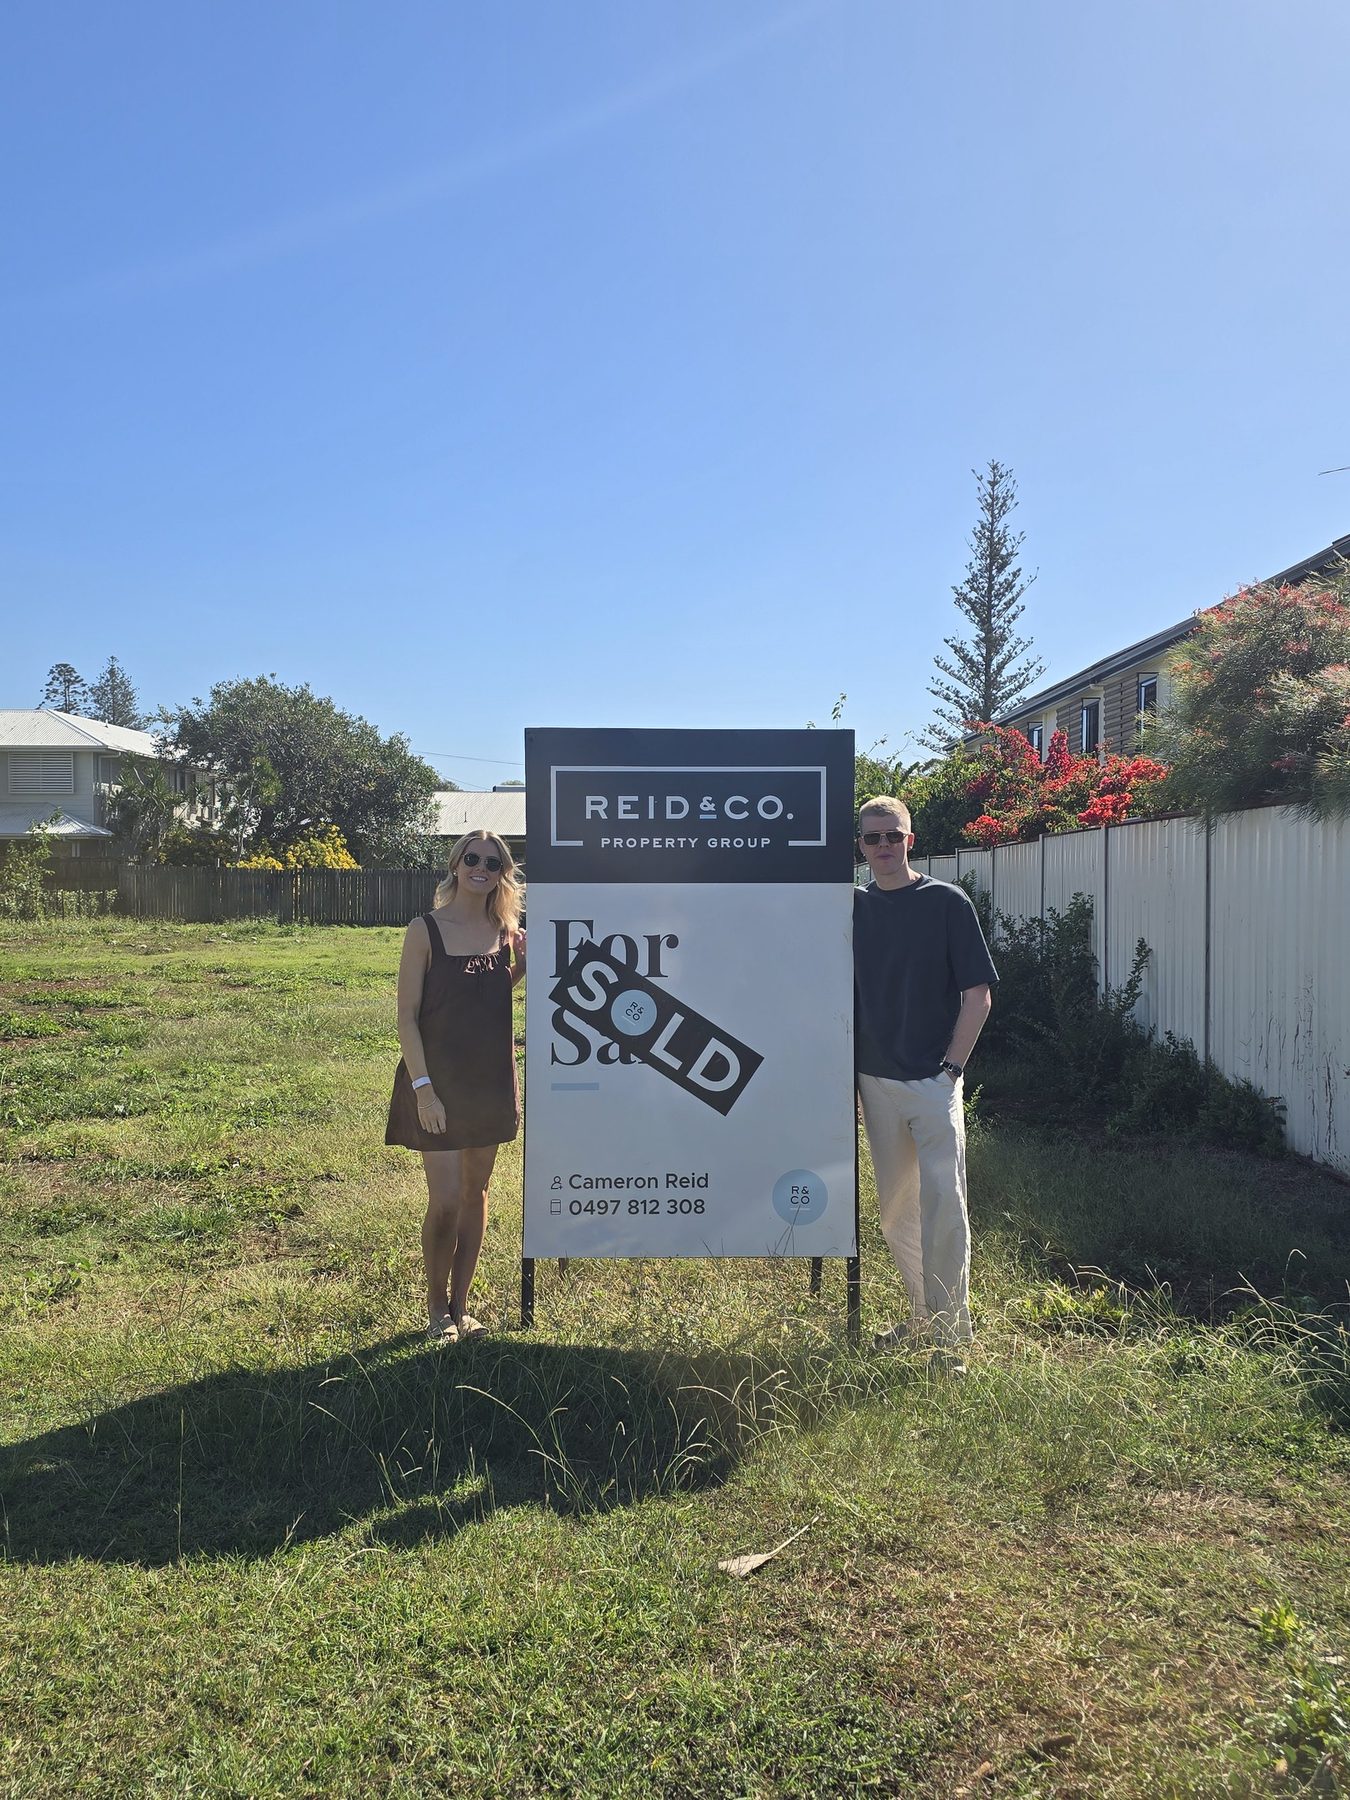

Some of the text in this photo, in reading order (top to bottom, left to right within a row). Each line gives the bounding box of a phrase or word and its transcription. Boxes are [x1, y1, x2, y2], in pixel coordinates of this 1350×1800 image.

[601, 838, 771, 848] PROPERTY GROUP
[549, 919, 680, 978] For
[550, 1006, 650, 1066] Sa
[568, 1172, 709, 1189] Cameron Reid
[568, 1199, 705, 1215] 0497 812 308
